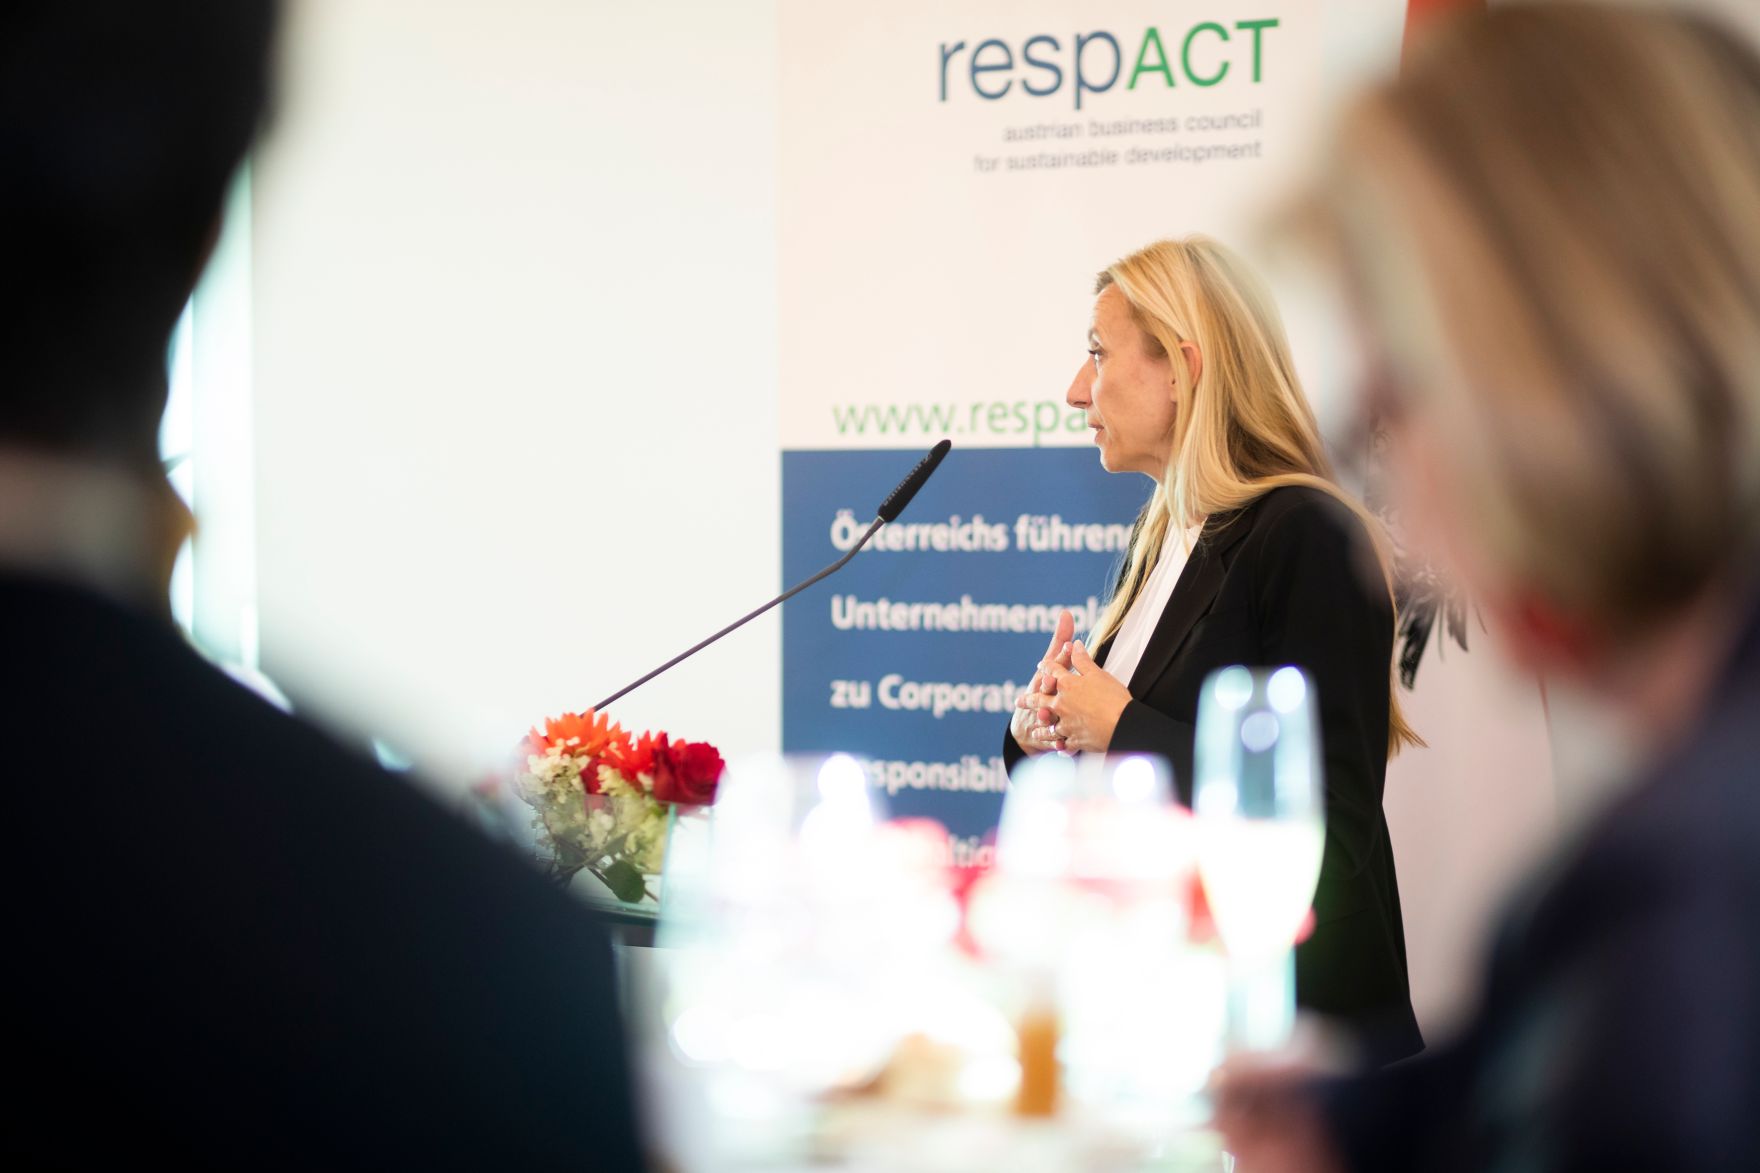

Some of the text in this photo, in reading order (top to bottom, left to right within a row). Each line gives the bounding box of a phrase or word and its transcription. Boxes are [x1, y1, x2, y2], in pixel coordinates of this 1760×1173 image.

[938, 18, 1280, 110] respACT
[1003, 109, 1262, 143] austrian business council
[974, 140, 1262, 172] for sustainable development
[830, 680, 871, 709] zu
